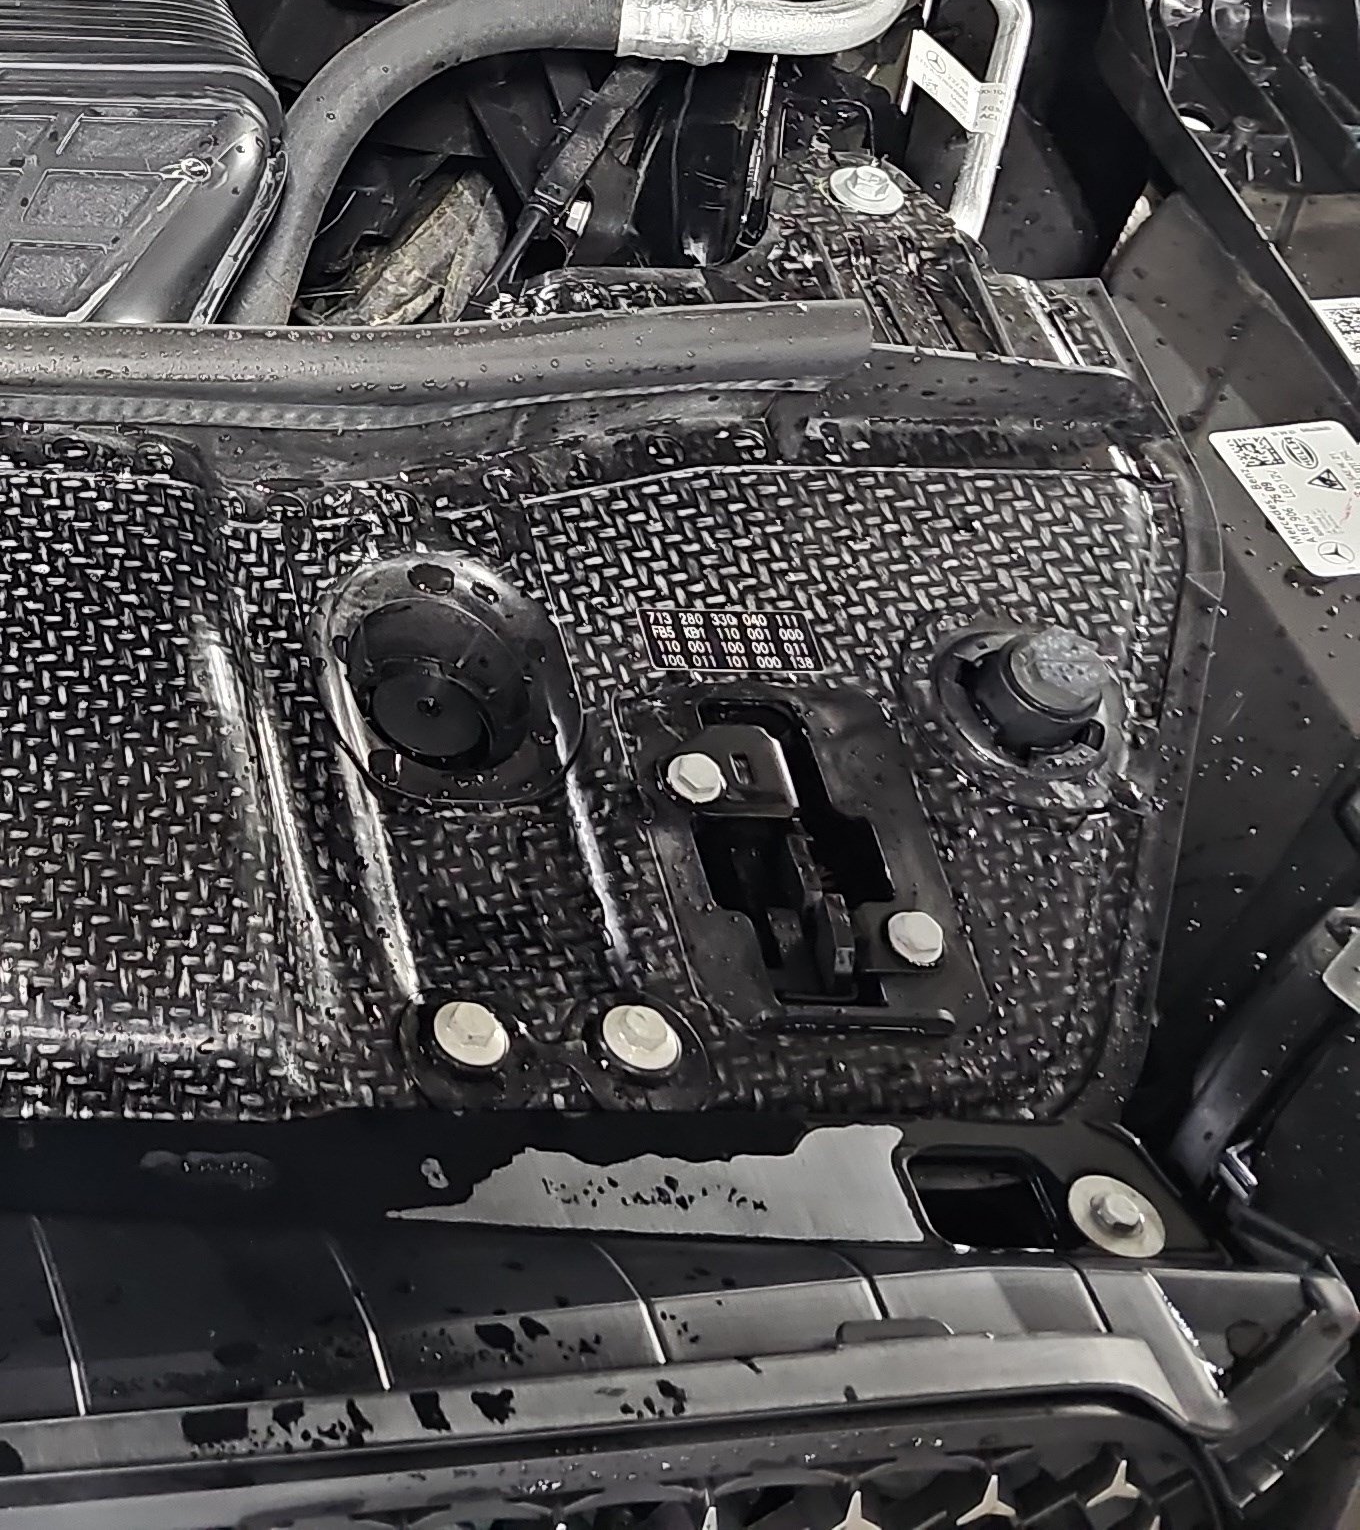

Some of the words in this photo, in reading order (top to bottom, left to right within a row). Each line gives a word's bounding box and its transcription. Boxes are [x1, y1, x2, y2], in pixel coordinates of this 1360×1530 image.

[1284, 437, 1312, 466] HELLA
[1240, 468, 1262, 490] Benz
[1261, 482, 1276, 492] 09
[1278, 483, 1297, 499] LED
[1281, 507, 1301, 522] 906
[1265, 500, 1305, 545] Mercedes
[1294, 522, 1311, 535] 167
[1307, 536, 1318, 544] A
[647, 612, 672, 625] 713
[679, 613, 703, 626] 280
[742, 614, 767, 627] 040
[775, 615, 798, 627] 111
[652, 626, 675, 638] FB5
[683, 627, 706, 639] KB1
[717, 628, 740, 640] 110
[747, 628, 771, 640] 001
[779, 629, 803, 641] 000
[657, 640, 680, 652] 110
[688, 641, 712, 653] 001
[721, 642, 745, 654] 100
[752, 642, 776, 654] 001
[784, 643, 808, 655] 011
[662, 654, 685, 667] 100
[693, 655, 716, 667] 011
[726, 656, 749, 668] 101
[757, 656, 781, 668] 000
[790, 656, 814, 668] 138
